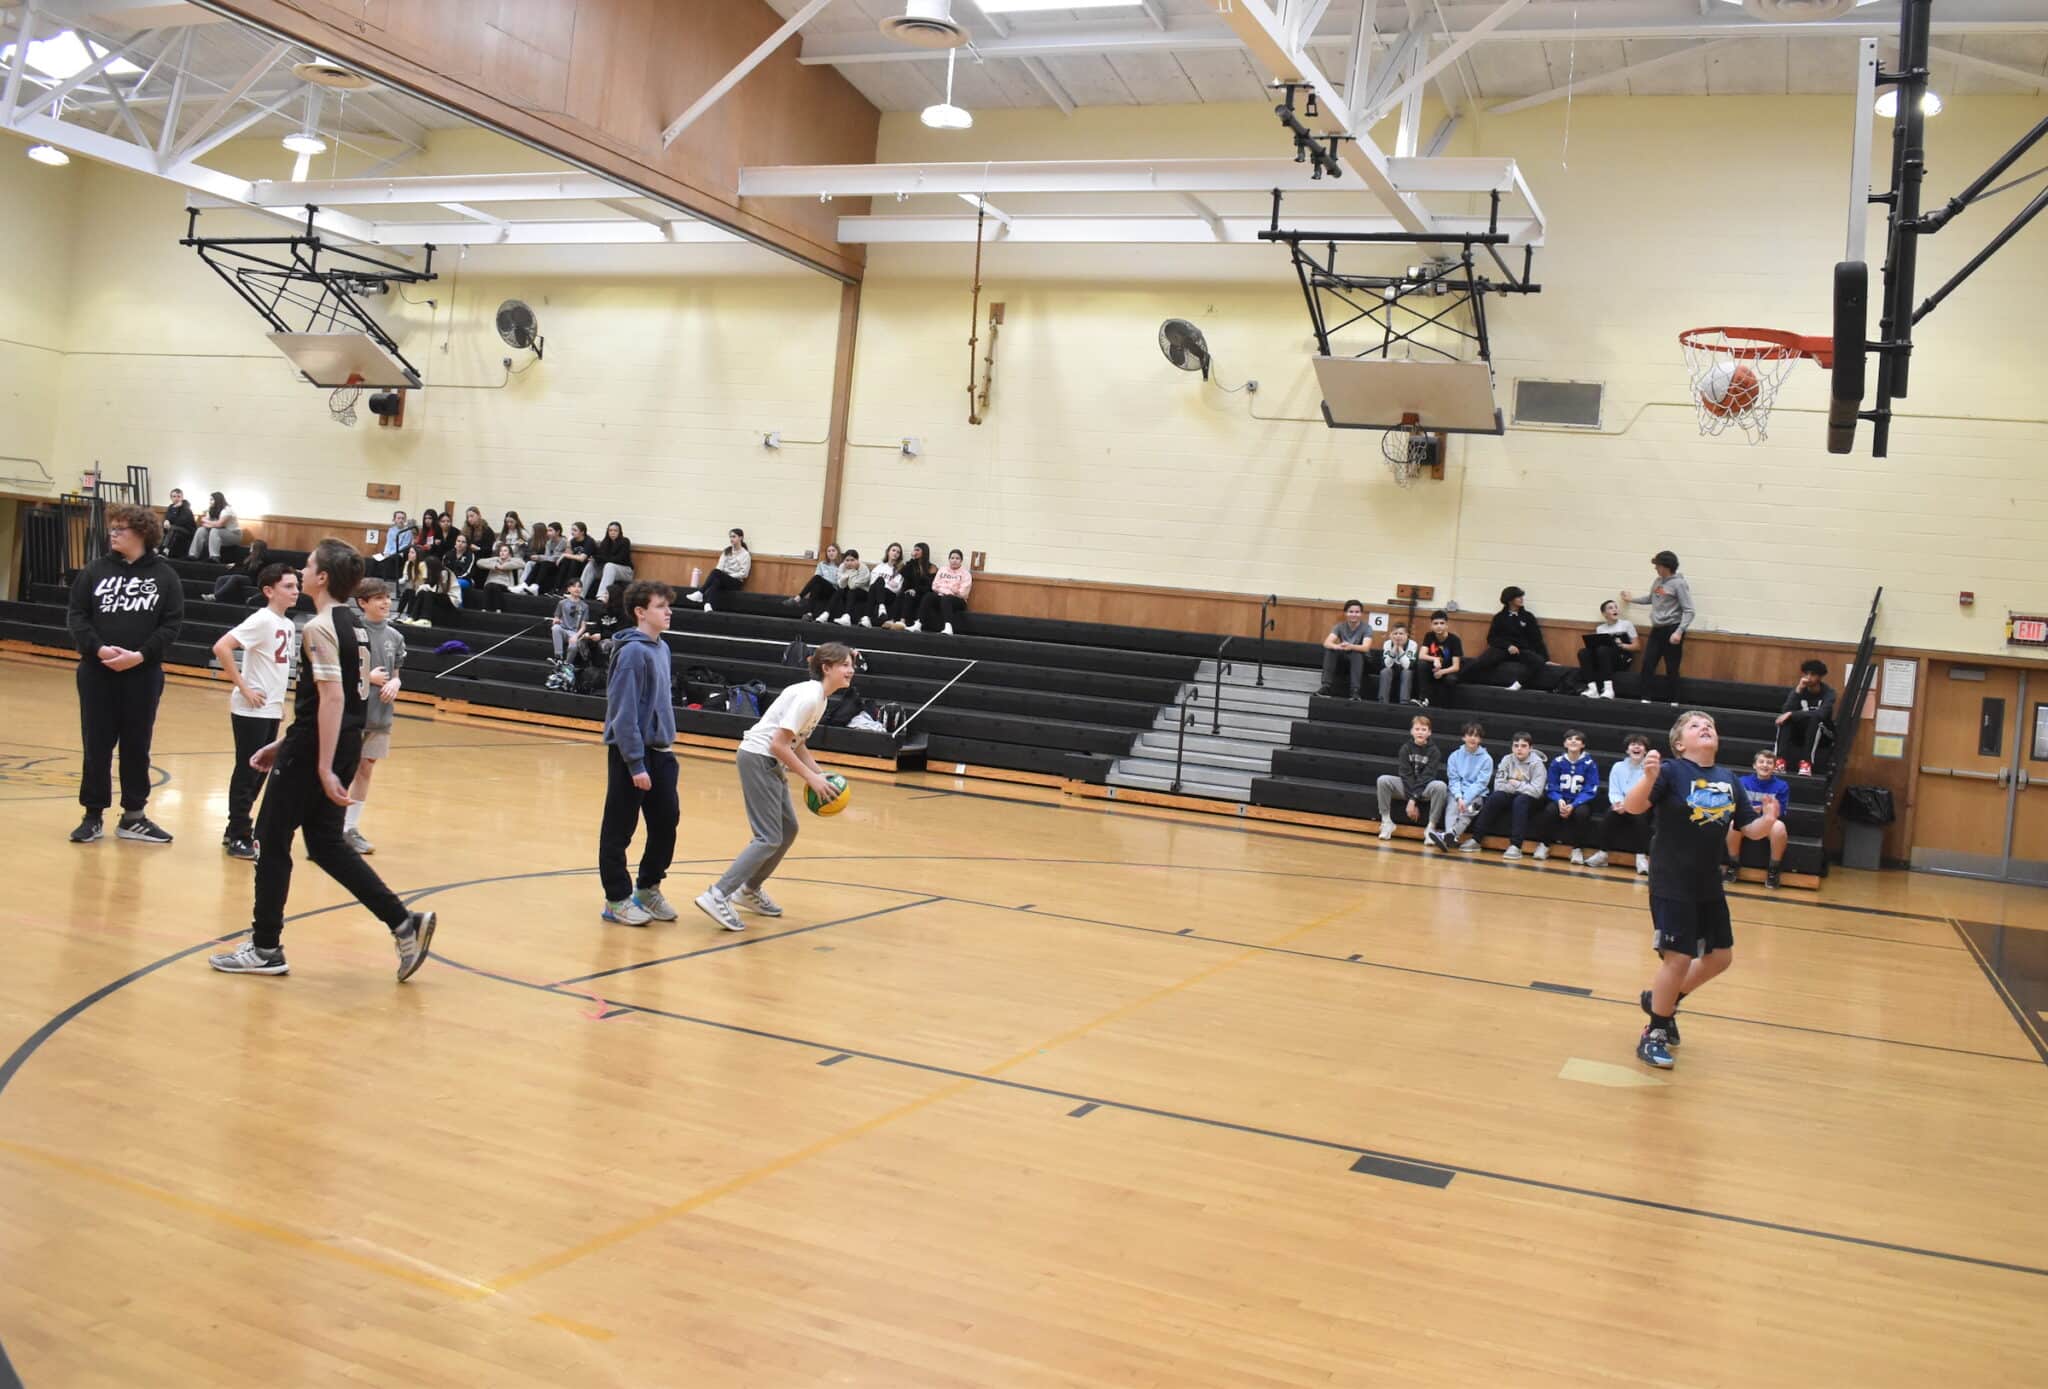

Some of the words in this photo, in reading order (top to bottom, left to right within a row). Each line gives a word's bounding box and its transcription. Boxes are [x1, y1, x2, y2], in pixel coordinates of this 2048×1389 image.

[102, 594, 115, 604] IS
[1375, 616, 1383, 626] 6
[2018, 622, 2044, 640] EXIT
[275, 629, 292, 664] 2
[1560, 774, 1585, 794] 26
